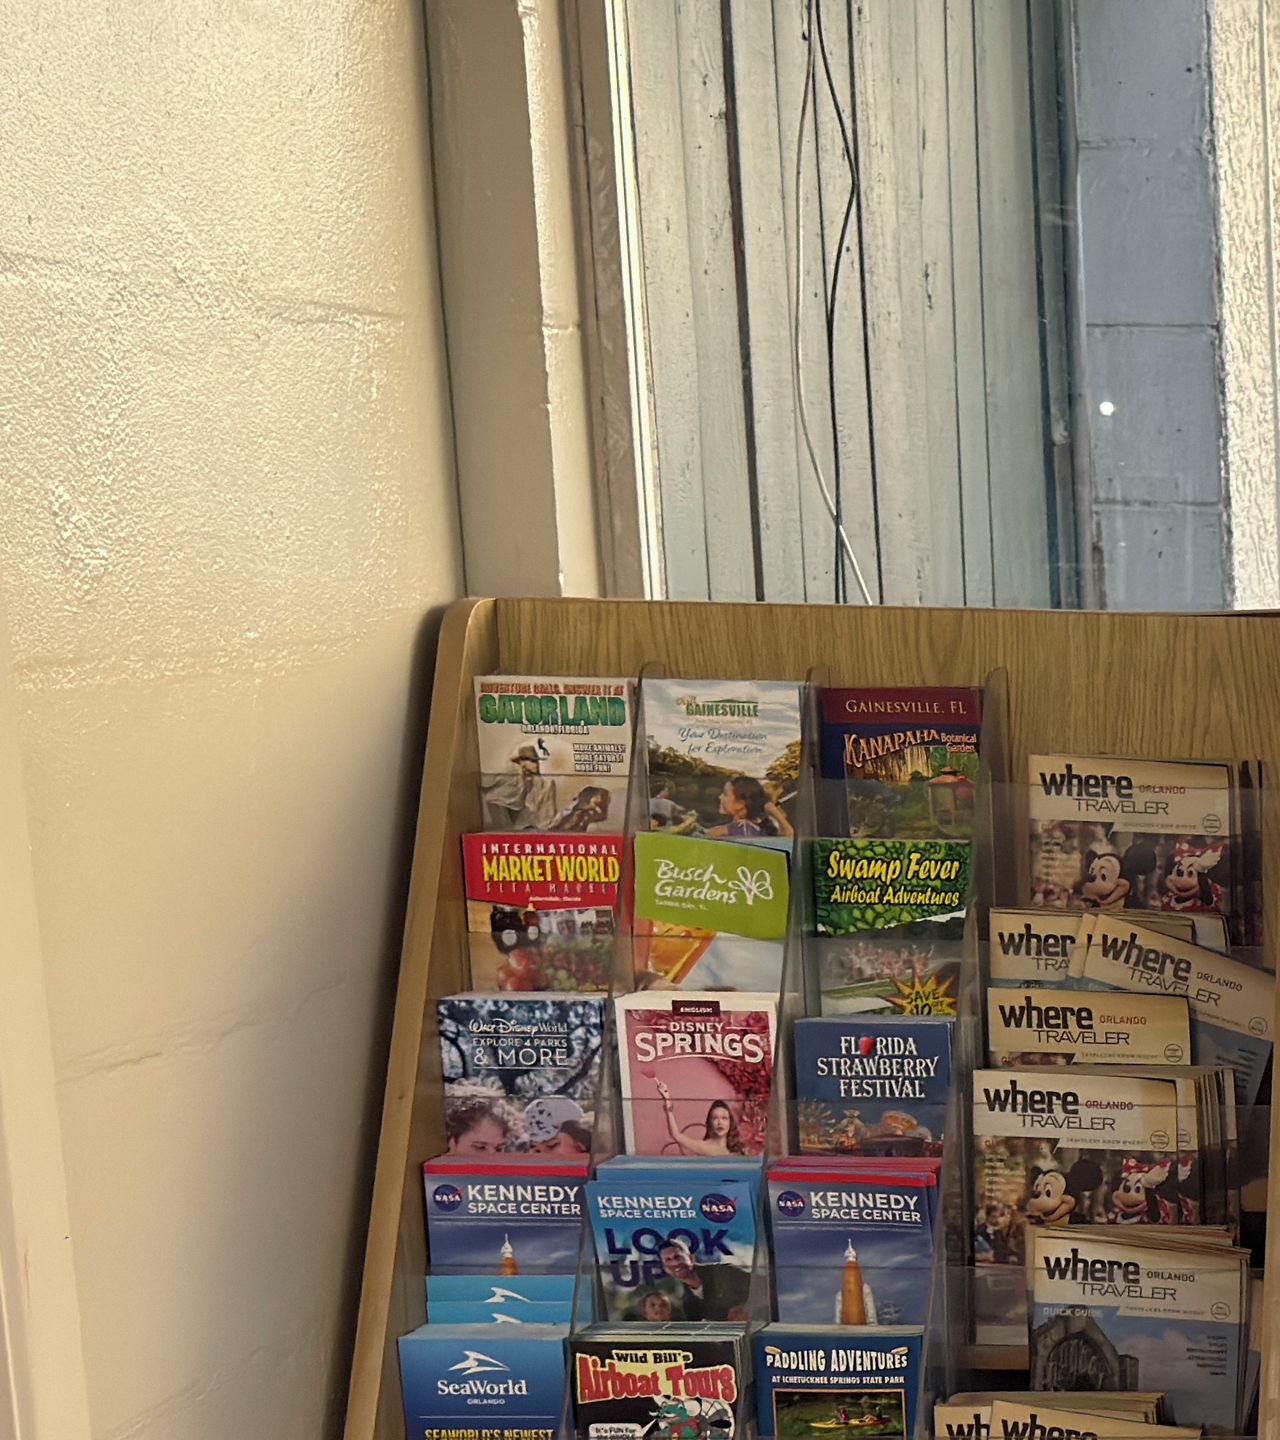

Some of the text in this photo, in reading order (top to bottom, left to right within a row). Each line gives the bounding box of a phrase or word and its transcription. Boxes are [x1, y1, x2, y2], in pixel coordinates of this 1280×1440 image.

[479, 694, 625, 726] GATORLAND
[686, 704, 759, 717] GAINESVILLE
[941, 733, 976, 742] Botanical
[844, 729, 939, 768] KANAPAHA
[1040, 763, 1186, 799] where ORLANDO
[1072, 798, 1169, 815] TRAVELER
[482, 844, 617, 855] INTERNATIONAL
[482, 856, 619, 882] MARKET WORLD
[653, 859, 727, 884] Busch
[827, 851, 960, 885] Swamp Fever
[655, 880, 737, 904] Gardens
[831, 885, 960, 906] Airboat Adventures
[1101, 932, 1192, 981] where
[1196, 972, 1243, 992] ORLANDO
[907, 988, 939, 1004] SAVE
[998, 996, 1147, 1030] where ORLANDO
[670, 1022, 724, 1032] DISNEY
[472, 1038, 520, 1047] EXPLORE
[534, 1039, 567, 1047] PARKS
[1033, 1030, 1130, 1045] TRAVELER
[474, 1048, 568, 1065] & MORE
[635, 1032, 764, 1063] SPRINGS
[817, 1055, 939, 1077] STRAWBERRY
[840, 1077, 925, 1098] FESTIVAL
[468, 1184, 579, 1202] KENNEDY
[810, 1192, 918, 1210] KENNEDY
[468, 1203, 581, 1215] SPACE CENTER
[598, 1196, 693, 1209] KENNEDY
[702, 1204, 734, 1213] NASA
[600, 1210, 696, 1218] SPACE CENTER
[812, 1209, 920, 1222] SPACE CENTER
[604, 1228, 734, 1256] LOOK
[610, 1261, 665, 1287] UP
[1043, 1248, 1195, 1284] where ORLANDO
[1076, 1282, 1176, 1300] TRAVELER
[615, 1352, 691, 1363] Wild Bill's
[766, 1349, 907, 1372] PADDLING ADVENTURES
[437, 1380, 528, 1395] SeaWorld
[578, 1356, 735, 1402] Airboat Tours
[782, 1376, 828, 1384] ICHETUCKNEE
